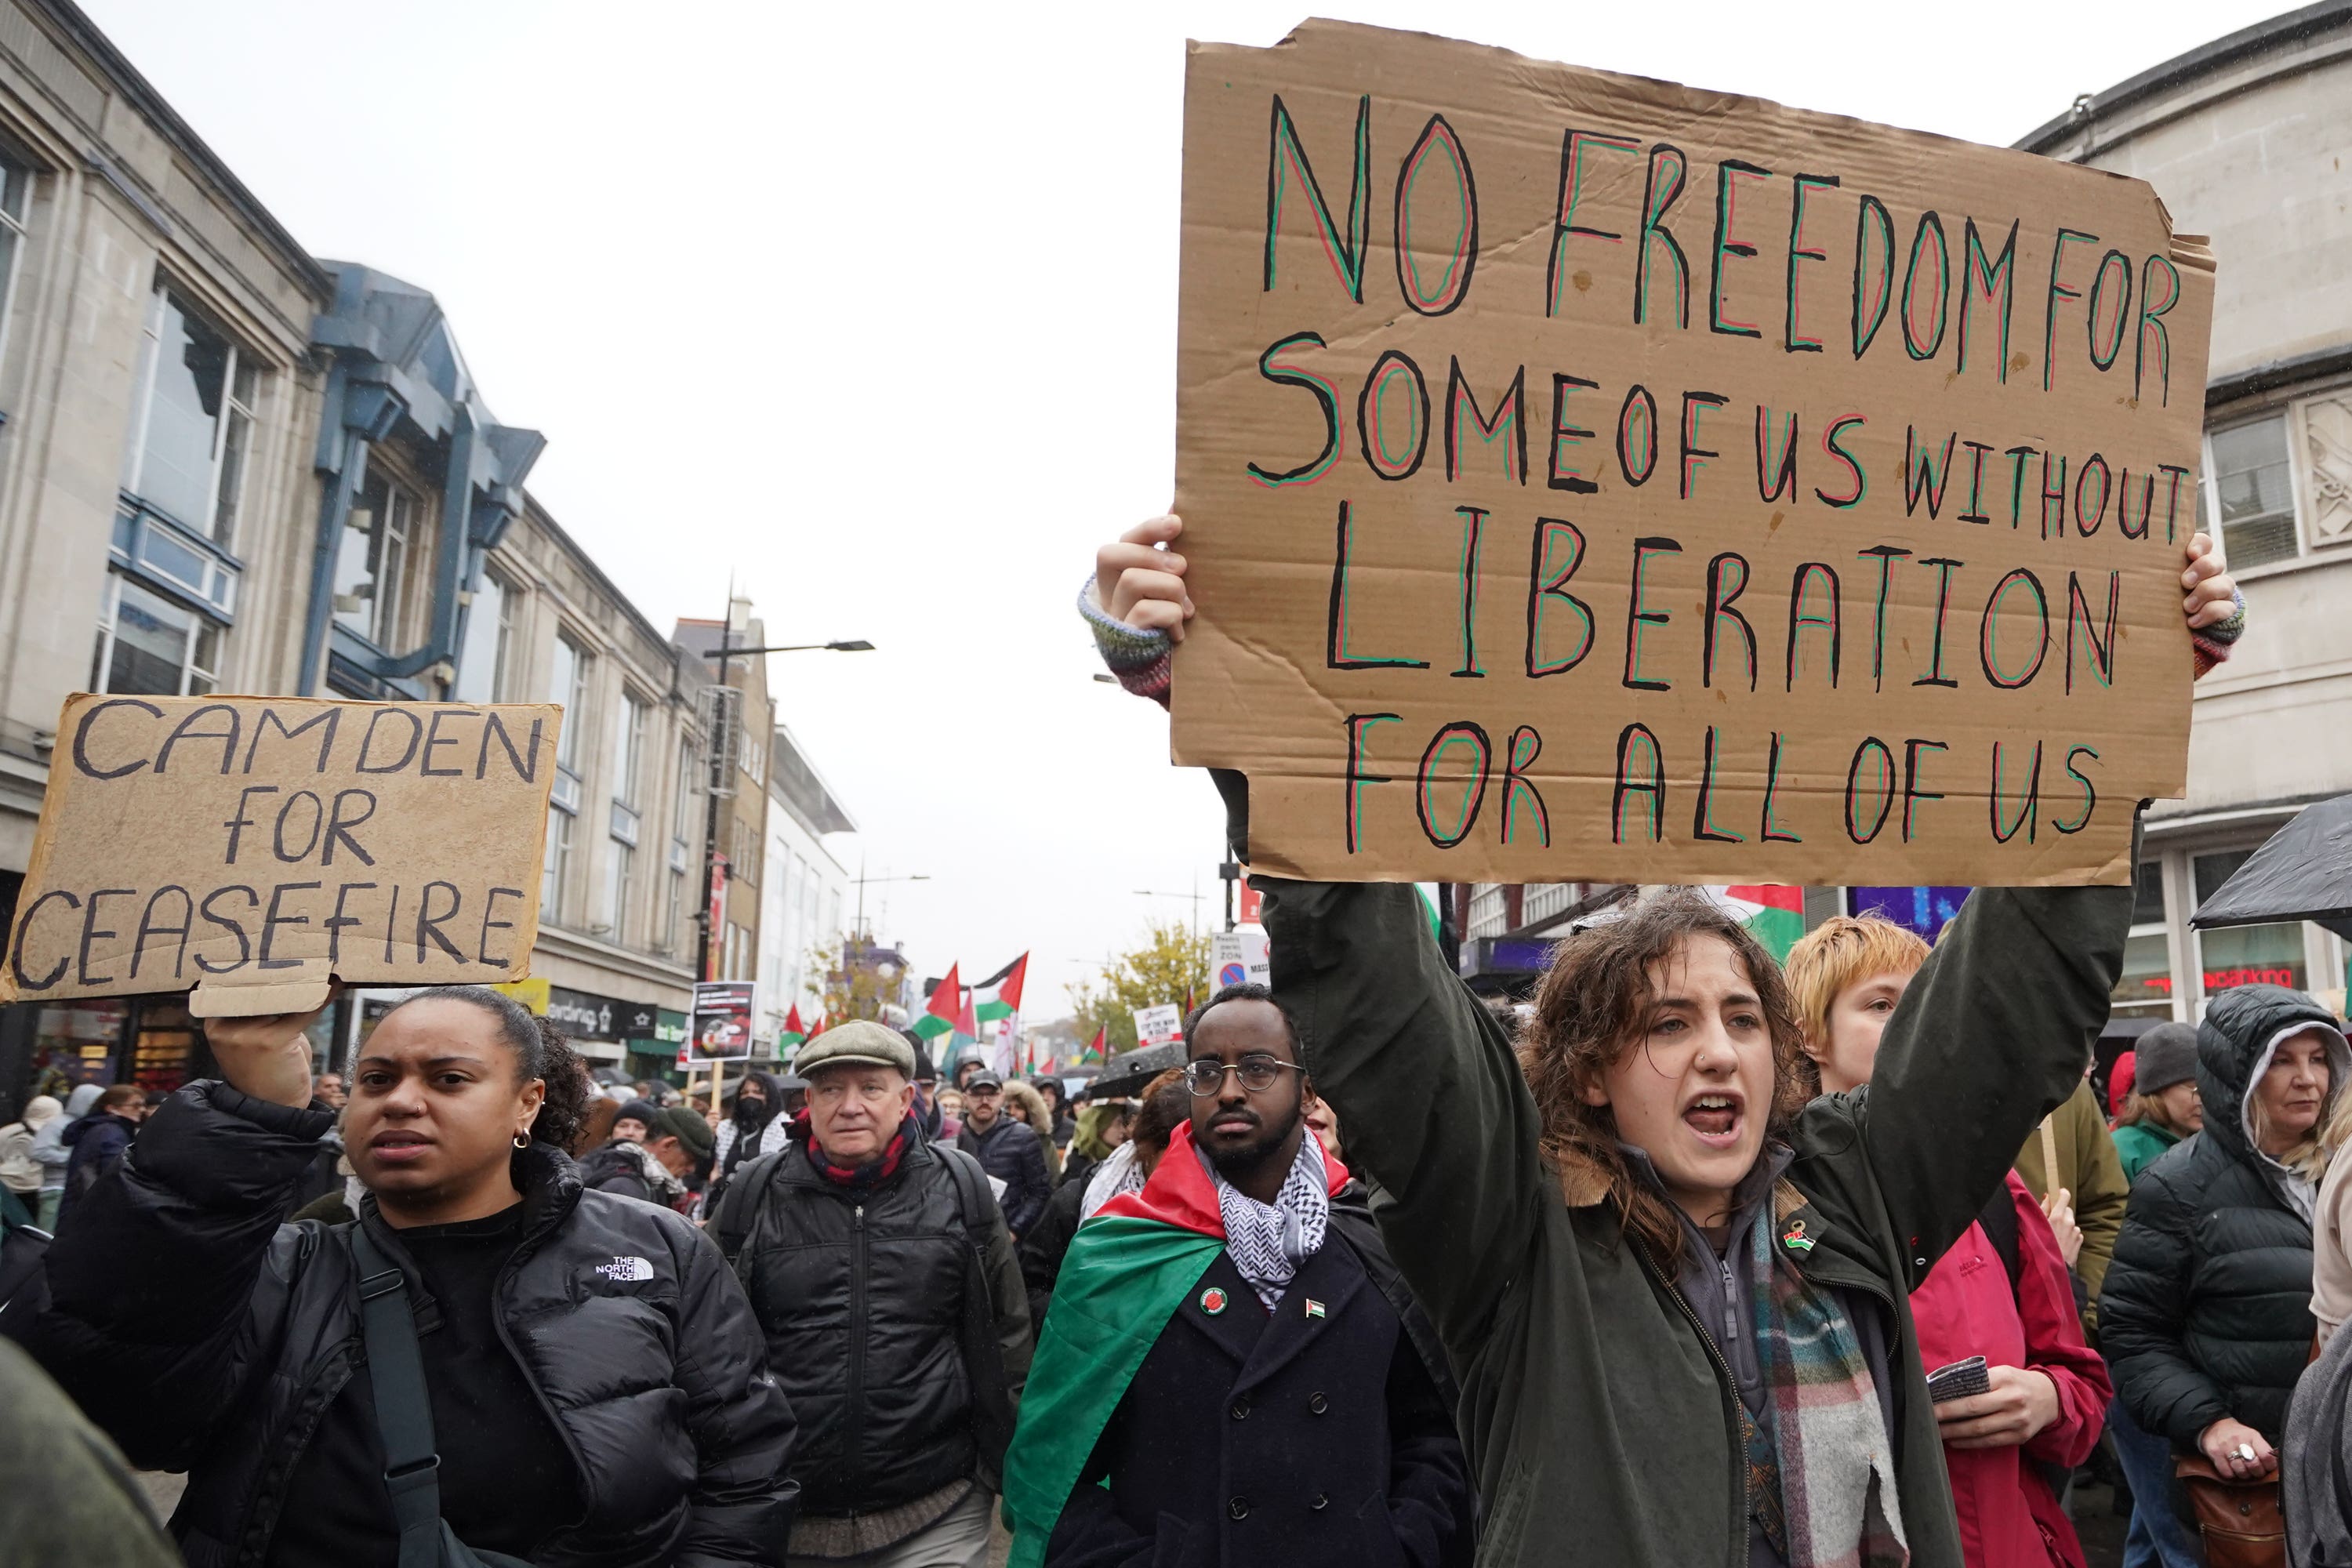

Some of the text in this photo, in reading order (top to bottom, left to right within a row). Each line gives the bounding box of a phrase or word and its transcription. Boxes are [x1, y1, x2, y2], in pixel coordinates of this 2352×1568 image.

[1264, 93, 2180, 407] NO FREEDOM FOR
[1755, 405, 1868, 509] US
[1904, 424, 2190, 545] WITHOUT
[1327, 499, 2119, 695] LIBERATION
[73, 699, 543, 783] CAMDEN
[1343, 713, 2102, 855] FOR ALL OF US
[223, 786, 376, 866] FOR
[11, 880, 525, 991] CEASEFIRE
[596, 1264, 633, 1273] NORTH
[608, 1272, 633, 1281] FACE
[613, 1256, 633, 1265] THE
